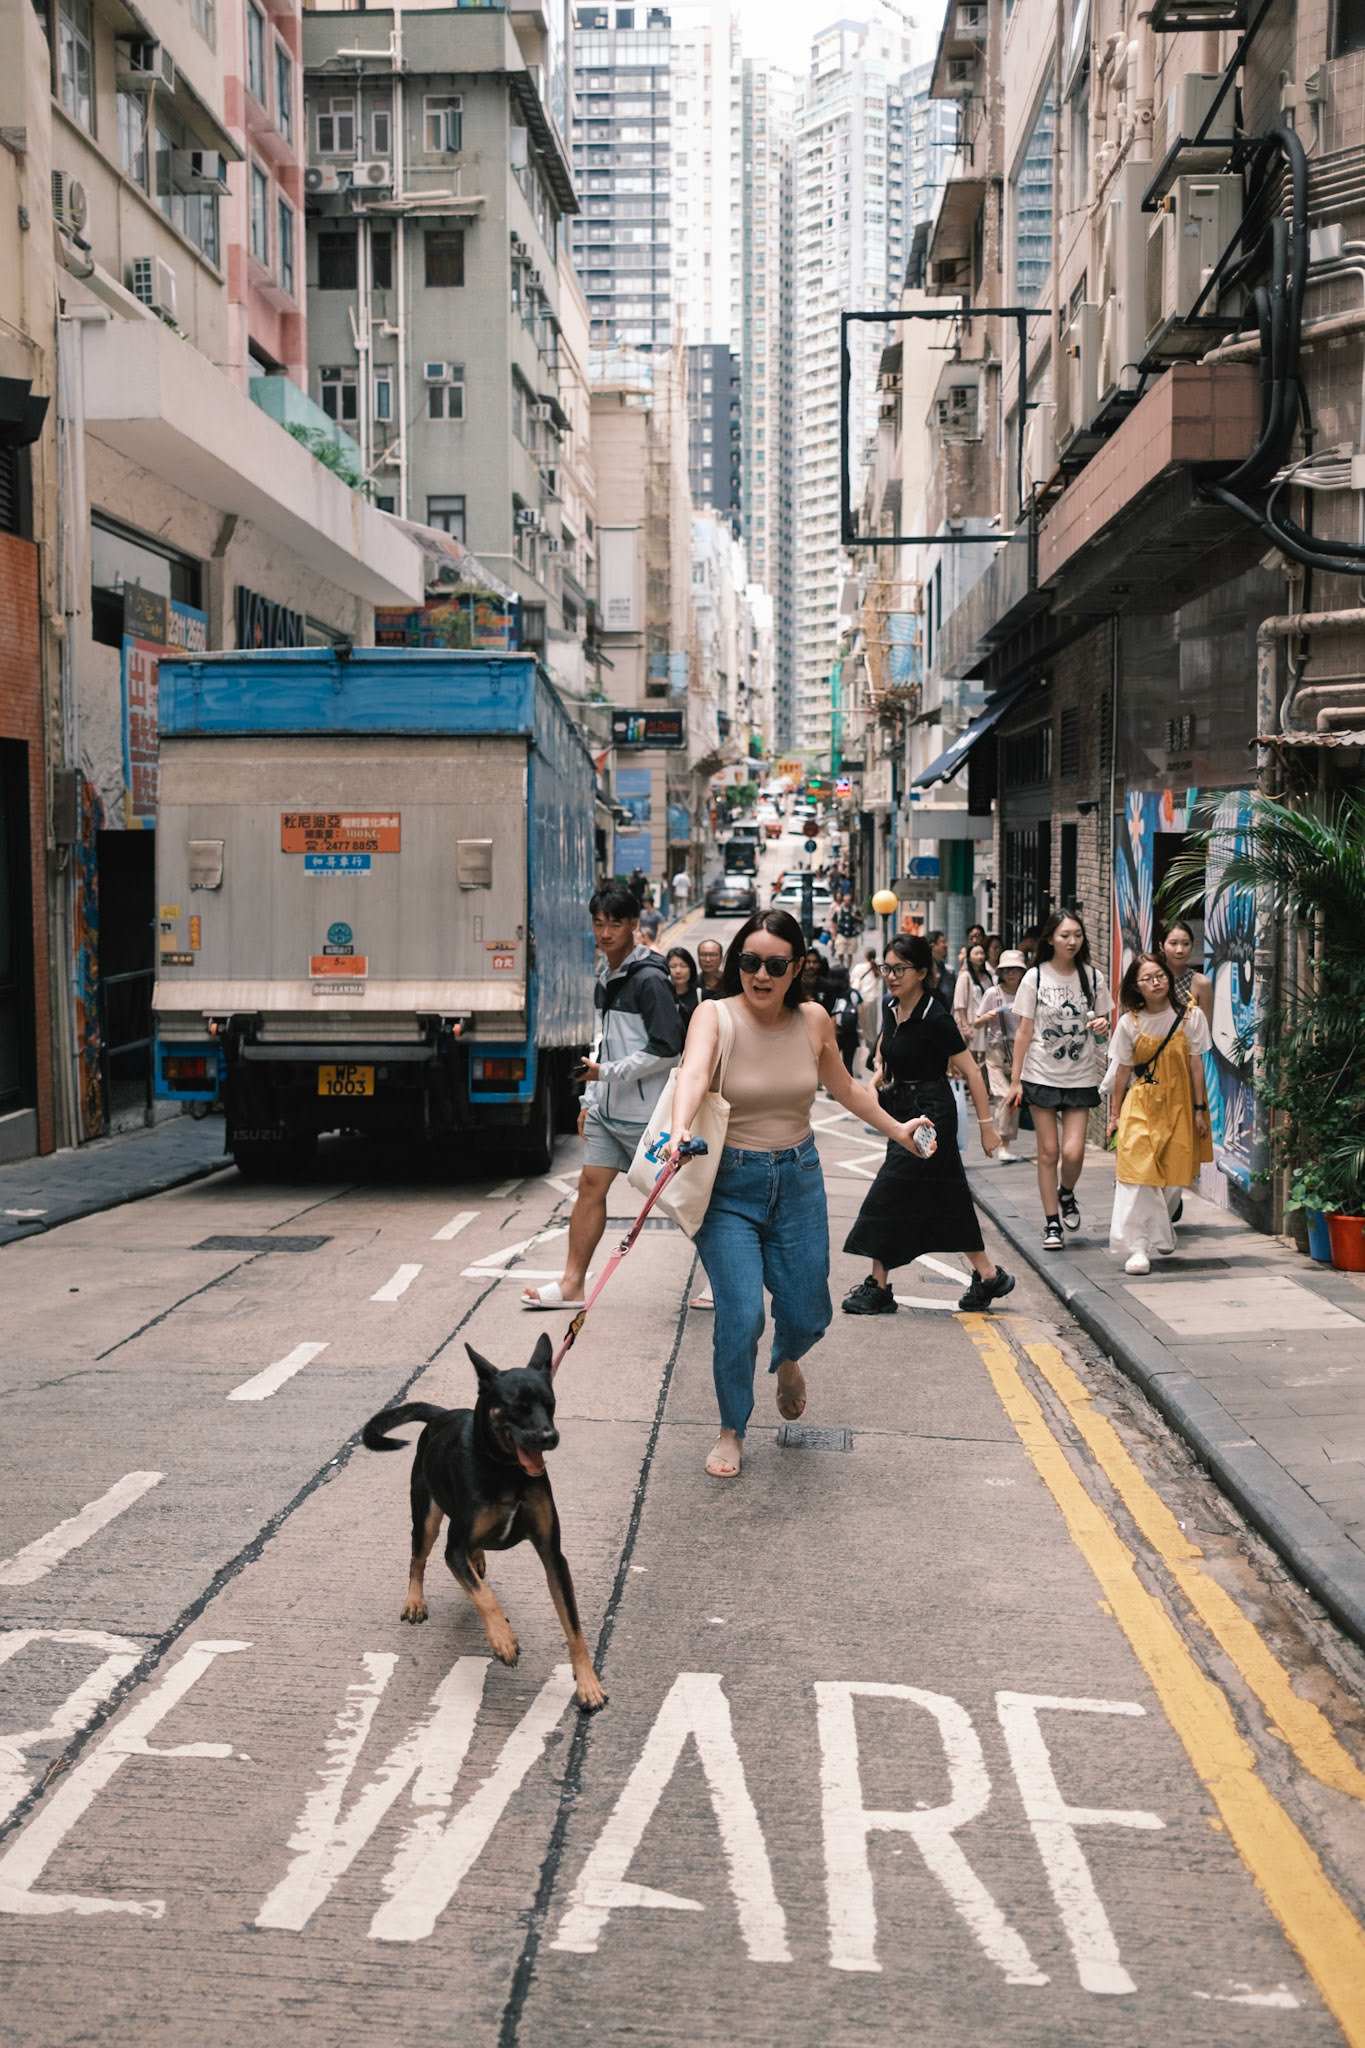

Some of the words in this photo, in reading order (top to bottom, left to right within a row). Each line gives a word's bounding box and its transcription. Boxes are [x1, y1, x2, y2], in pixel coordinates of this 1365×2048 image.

[239, 586, 306, 649] KATANA
[313, 985, 364, 994] DHOLLANDIA
[335, 1066, 358, 1081] WP
[326, 1080, 366, 1094] 1003
[233, 1129, 283, 1141] ISUZU
